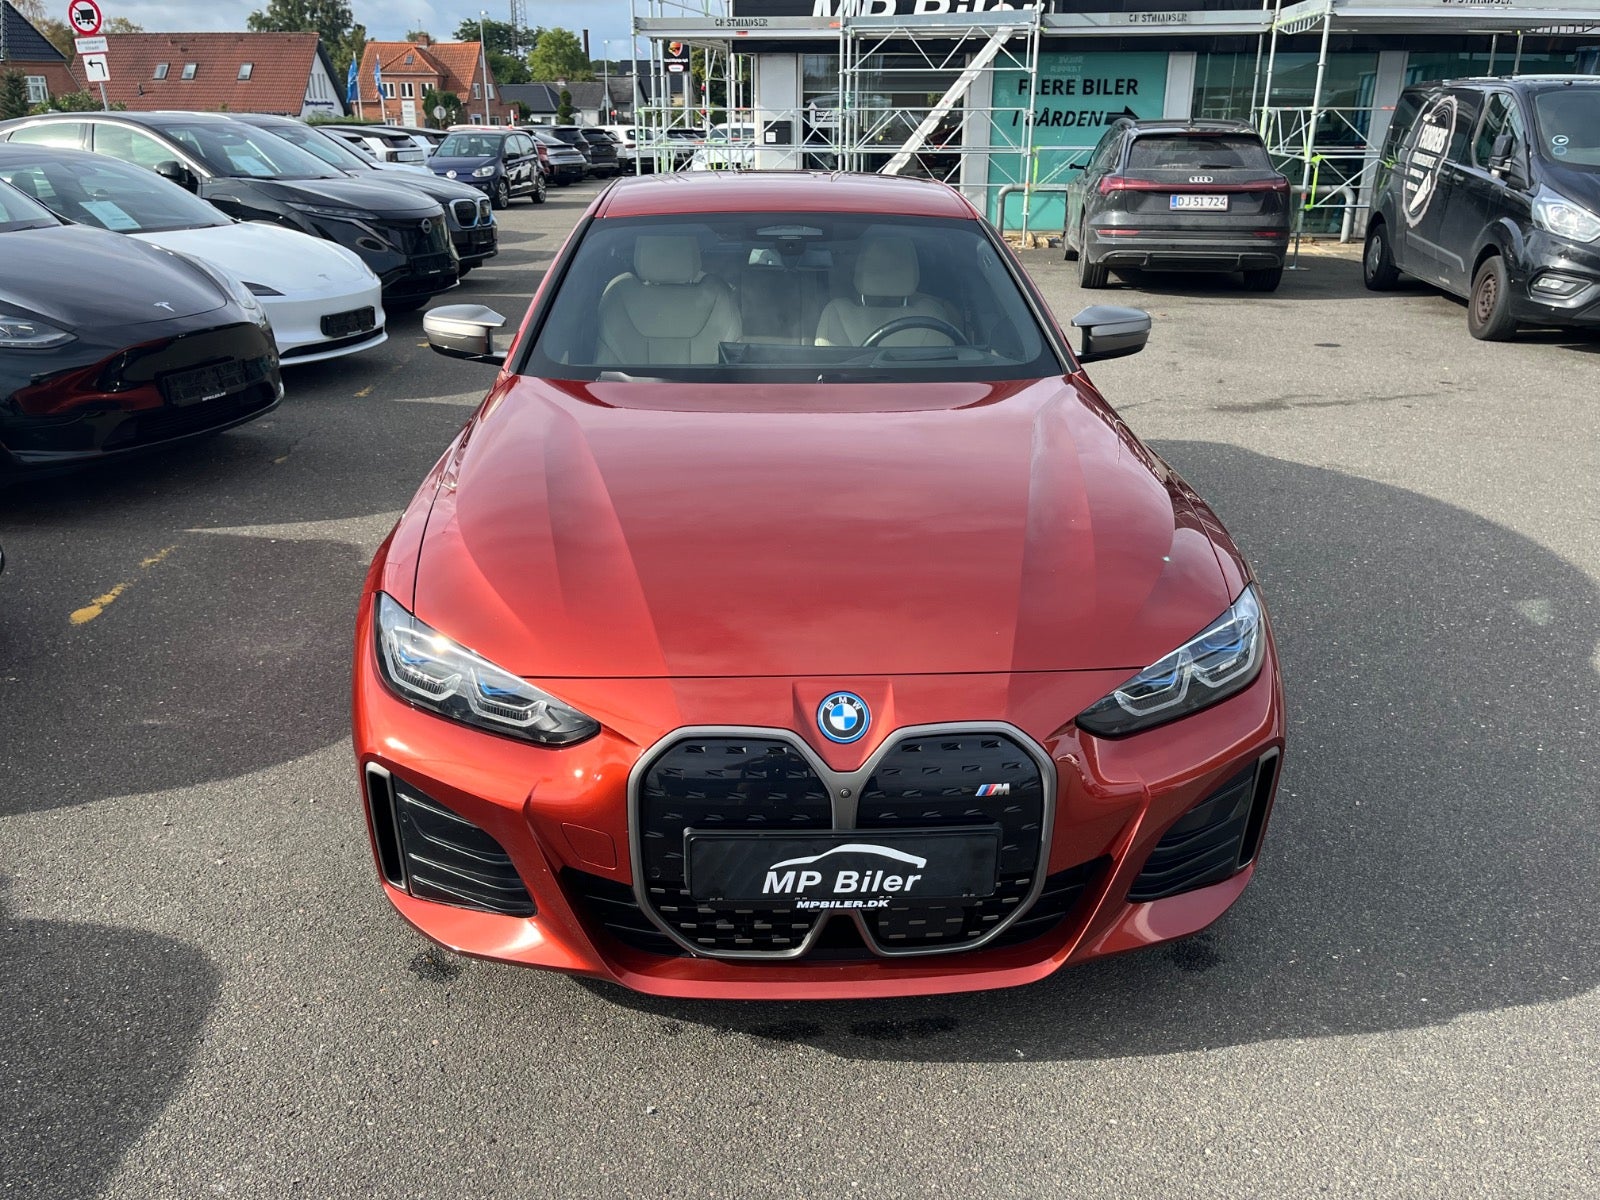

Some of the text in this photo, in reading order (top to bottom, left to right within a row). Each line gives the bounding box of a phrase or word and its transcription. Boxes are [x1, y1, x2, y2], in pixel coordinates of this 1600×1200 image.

[1018, 78, 1139, 96] FLERE BILER
[1208, 196, 1226, 207] 724
[825, 696, 862, 710] BMW
[762, 870, 922, 894] MP Biler
[796, 899, 891, 910] MPBILER.DK
